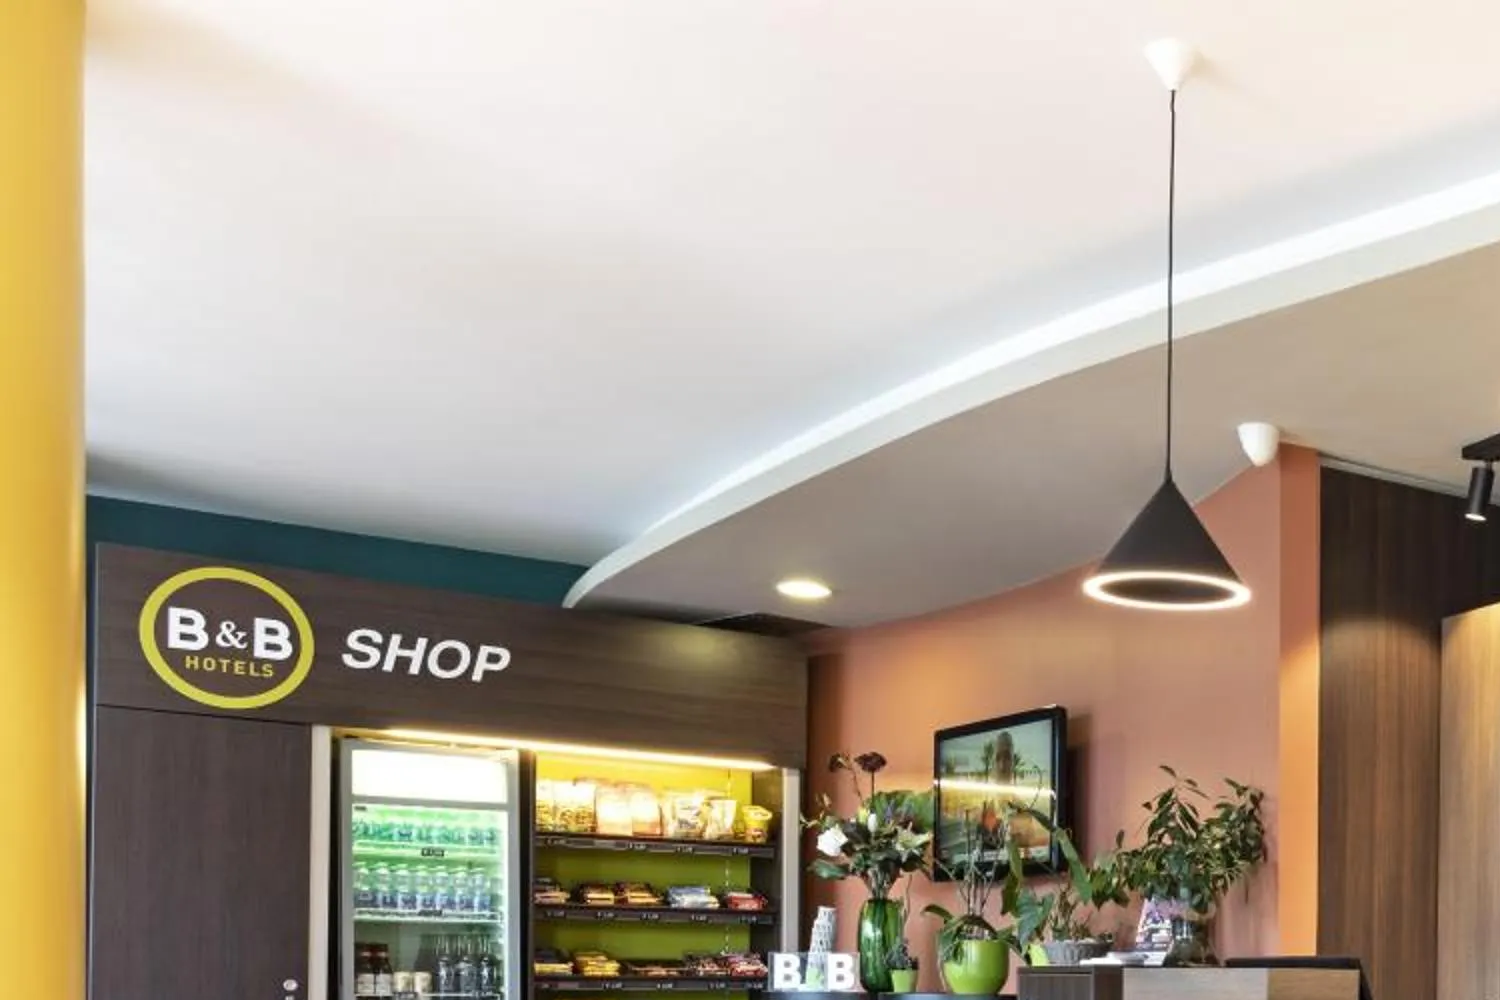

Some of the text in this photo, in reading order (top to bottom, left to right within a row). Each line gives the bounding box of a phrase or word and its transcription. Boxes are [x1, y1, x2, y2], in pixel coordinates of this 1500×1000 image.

[167, 606, 293, 661] B&B
[342, 628, 511, 683] SHOP
[184, 654, 274, 678] HOTELS
